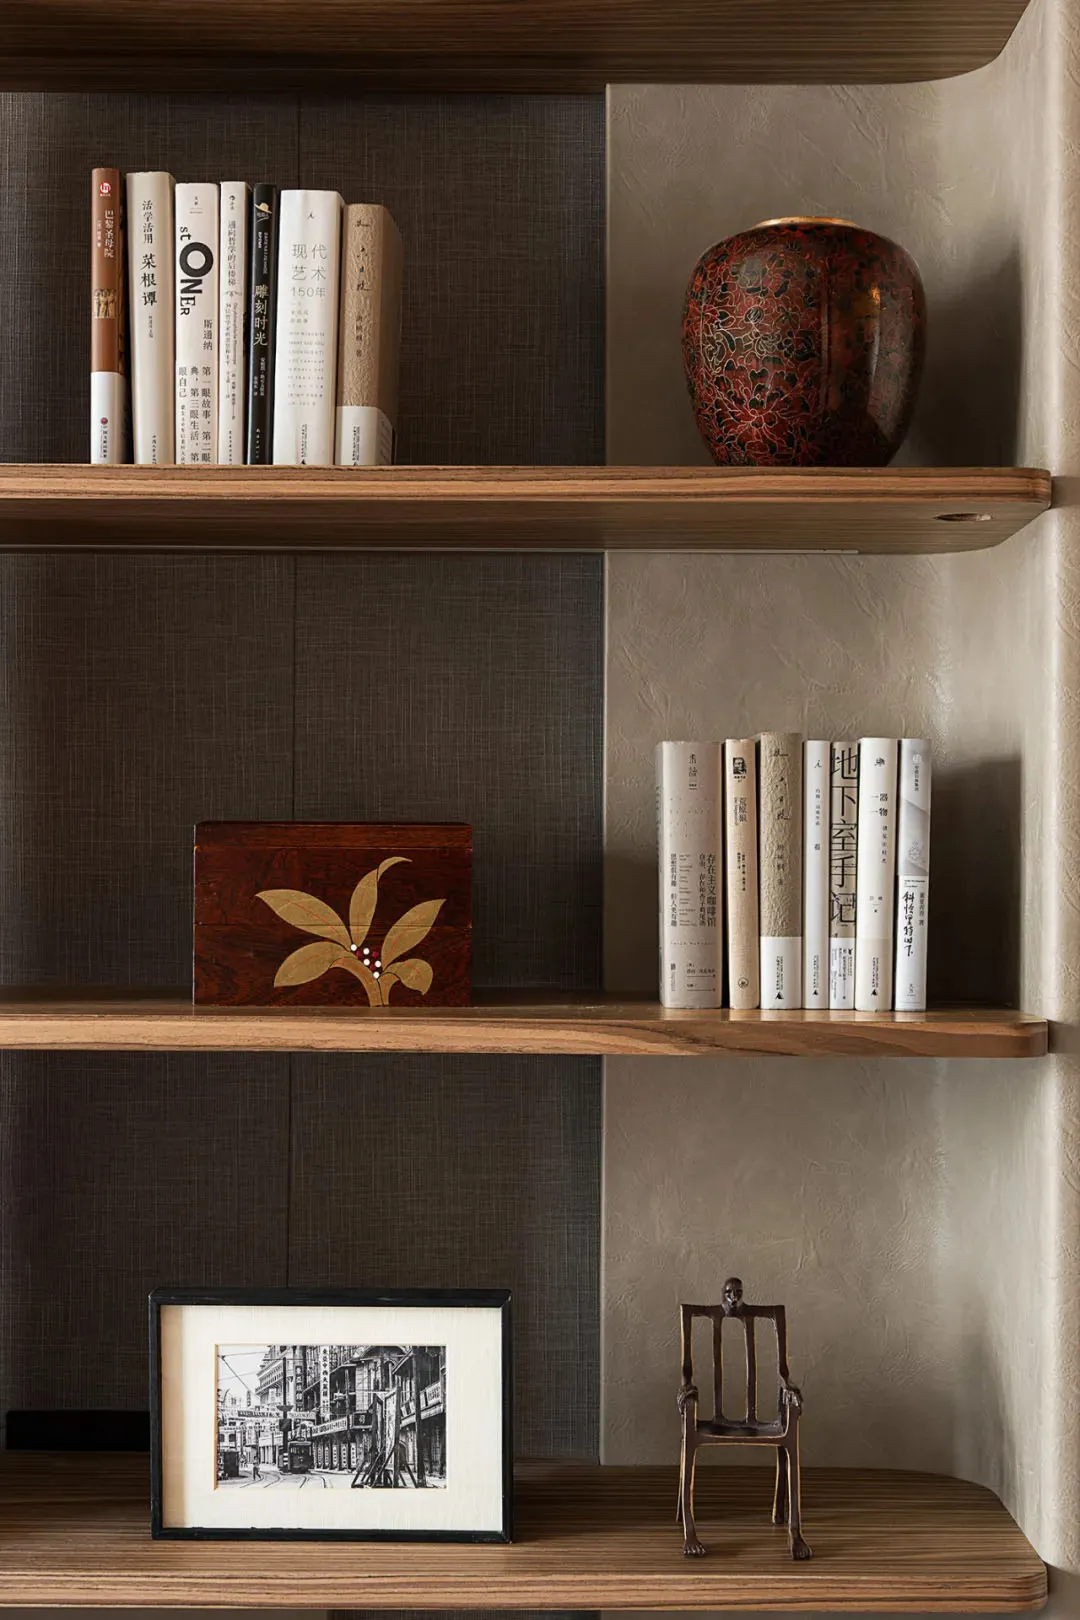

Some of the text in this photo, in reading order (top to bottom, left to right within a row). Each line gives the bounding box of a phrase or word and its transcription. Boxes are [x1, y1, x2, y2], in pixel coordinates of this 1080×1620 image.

[104, 209, 114, 258] 巴黎圣母院
[142, 200, 154, 244] 活学活用
[291, 243, 328, 260] 现代
[291, 265, 327, 281] 艺术
[140, 253, 157, 307] 菜根谭
[290, 286, 327, 298] 150年
[203, 319, 213, 351] 斯道纳
[254, 284, 269, 346] 雕刻时光
[178, 366, 188, 398] 眼自己
[831, 747, 858, 923] 地下室手记
[707, 853, 717, 928] 存在主义咖啡馆
